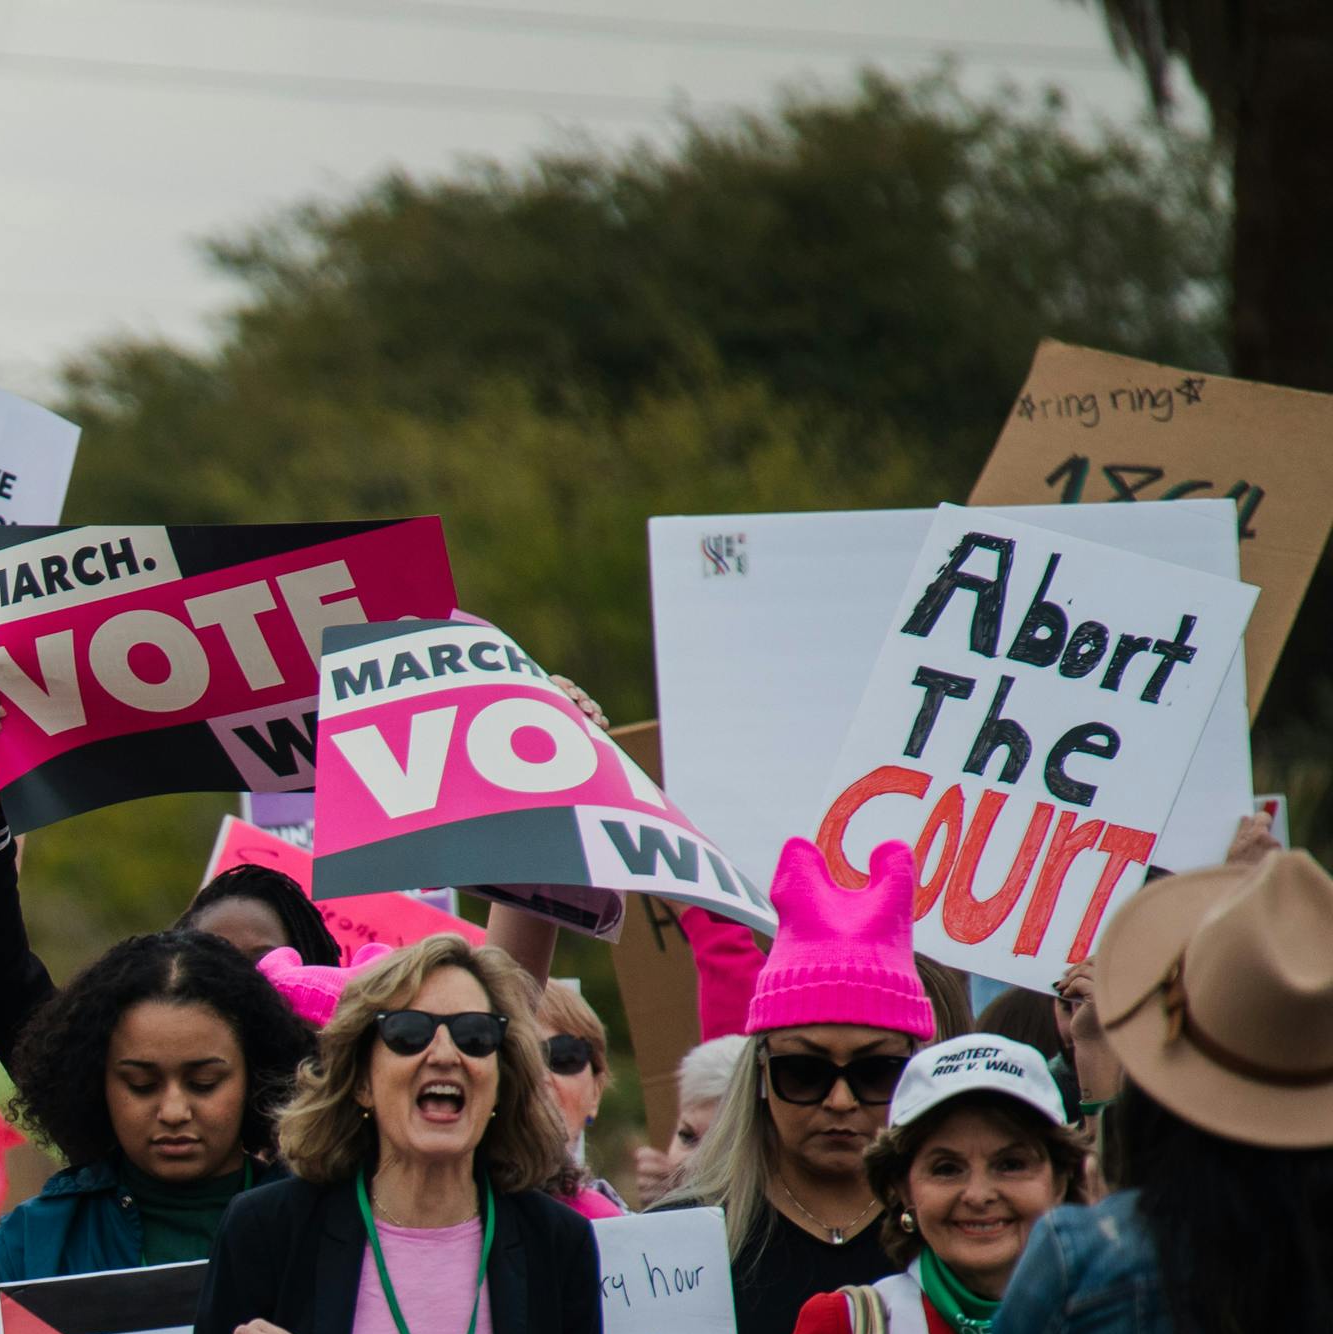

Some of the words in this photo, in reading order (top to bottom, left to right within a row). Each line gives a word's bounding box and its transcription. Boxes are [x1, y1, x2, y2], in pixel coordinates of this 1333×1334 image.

[900, 531, 1197, 704] Abort
[903, 666, 1120, 807] The
[932, 1062, 965, 1077] ROE
[985, 1060, 1026, 1078] WADE
[935, 1047, 1002, 1065] PROTECT
[642, 1253, 705, 1298] hour
